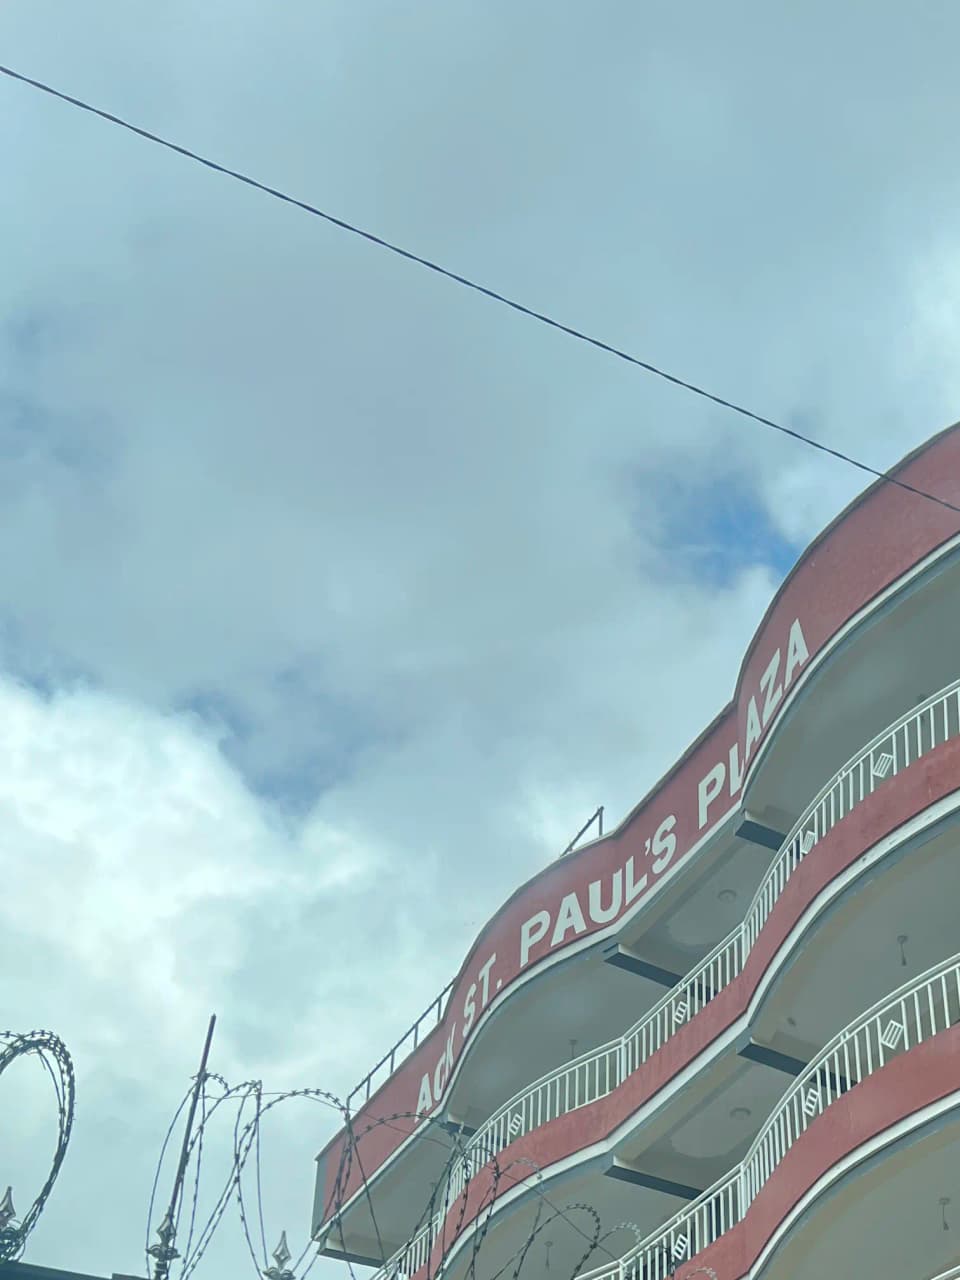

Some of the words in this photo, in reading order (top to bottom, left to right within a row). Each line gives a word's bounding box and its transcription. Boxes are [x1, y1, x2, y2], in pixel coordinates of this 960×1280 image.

[414, 1022, 457, 1124] ACK
[462, 953, 503, 1033] ST.
[519, 814, 677, 967] PAUL'S
[697, 617, 810, 830] PLAZA
